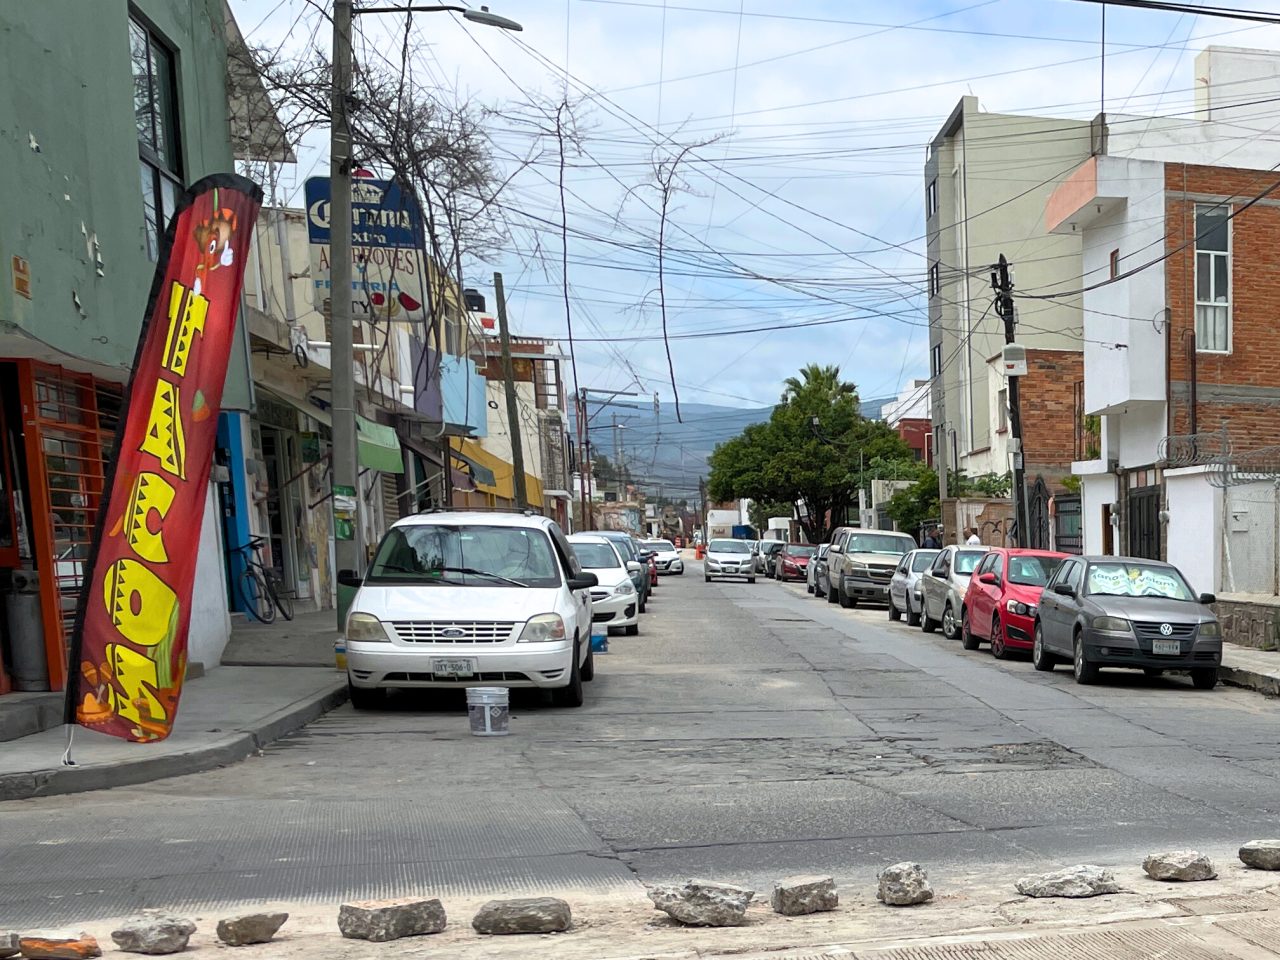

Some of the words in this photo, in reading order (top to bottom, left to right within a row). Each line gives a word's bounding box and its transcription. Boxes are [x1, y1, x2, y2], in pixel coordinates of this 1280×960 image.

[309, 199, 411, 229] Crona
[318, 246, 415, 275] ARROTES
[103, 280, 210, 727] TACOS
